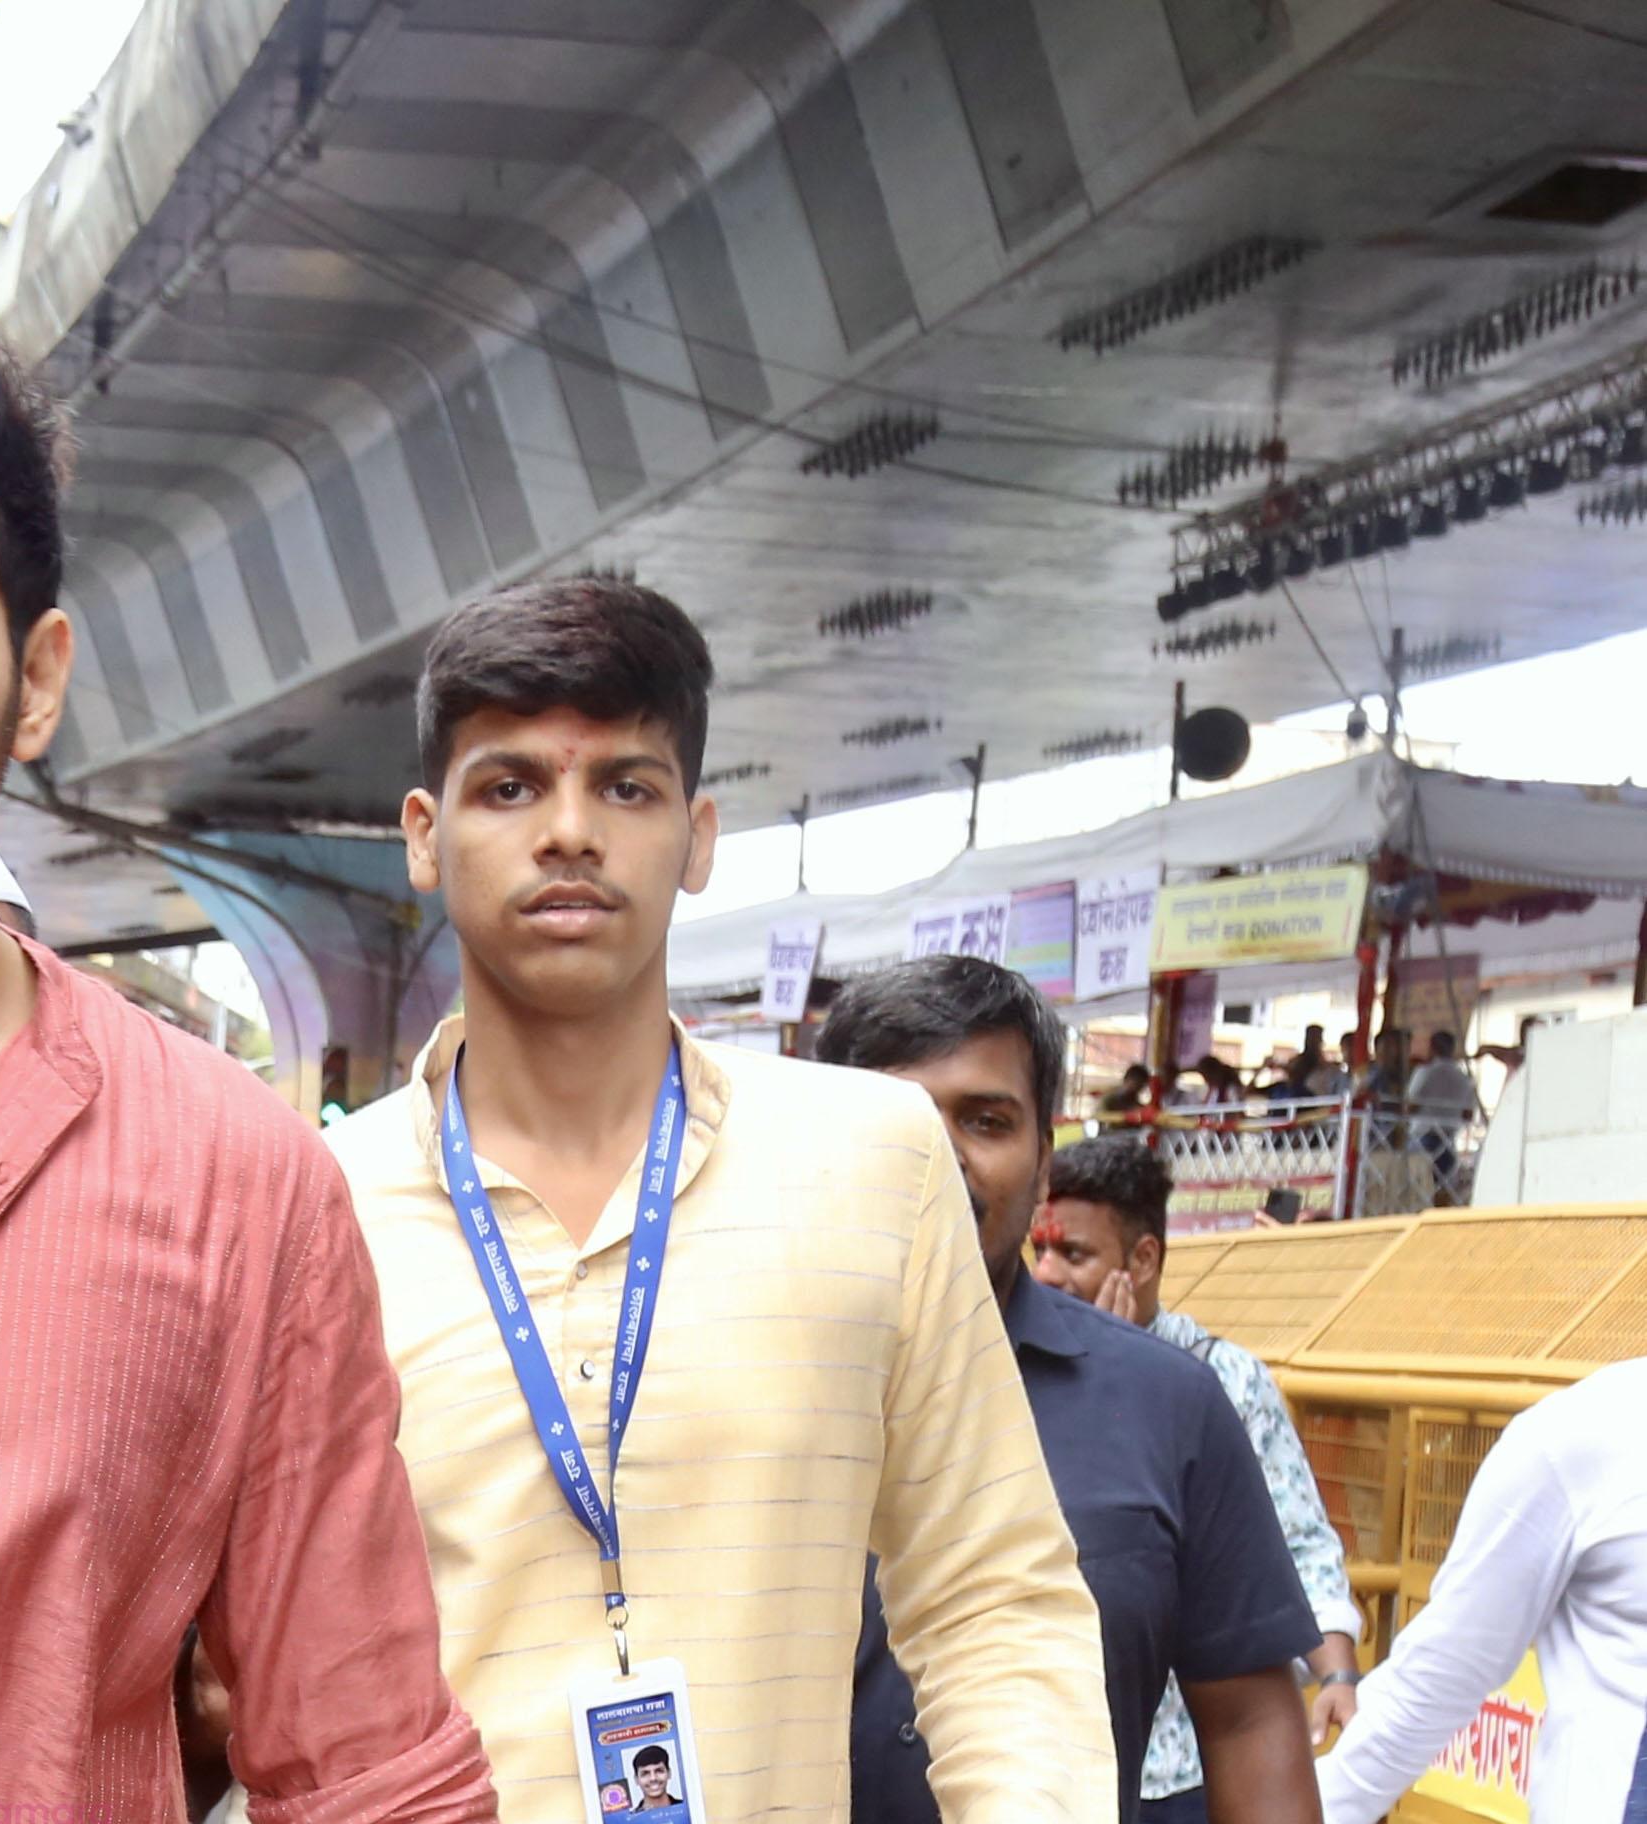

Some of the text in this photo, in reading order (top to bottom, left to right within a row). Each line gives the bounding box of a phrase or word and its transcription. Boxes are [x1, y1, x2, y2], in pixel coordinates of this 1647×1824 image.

[1250, 916, 1323, 940] DONATION
[471, 1206, 519, 1315] लालबागचा राजा
[615, 1287, 645, 1405] लालबागचा राजा
[561, 1450, 582, 1482] राजा
